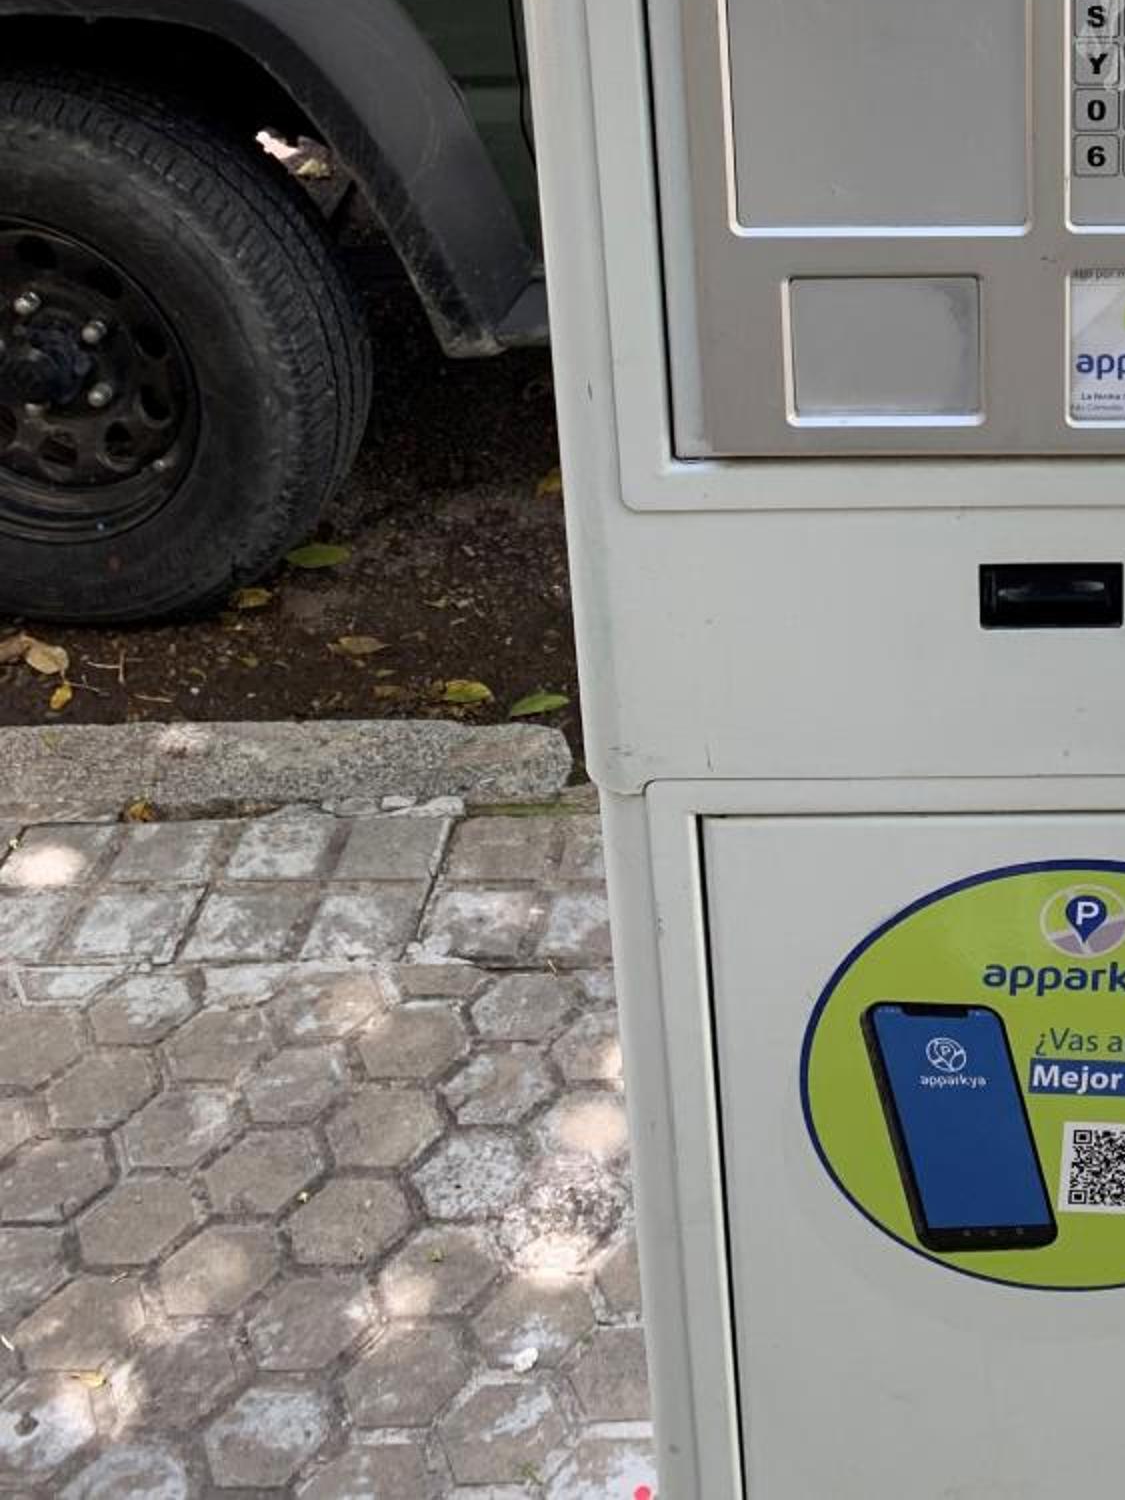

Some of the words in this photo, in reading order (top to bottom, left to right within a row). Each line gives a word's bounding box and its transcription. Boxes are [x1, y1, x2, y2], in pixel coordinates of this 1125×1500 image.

[1086, 5, 1106, 29] S
[1088, 53, 1108, 75] Y
[1087, 99, 1107, 122] 0
[1087, 145, 1106, 168] 6
[1034, 1029, 1099, 1056] ¿Vas
[920, 1075, 986, 1089] apparkya
[1032, 1065, 1122, 1096] Mejor
